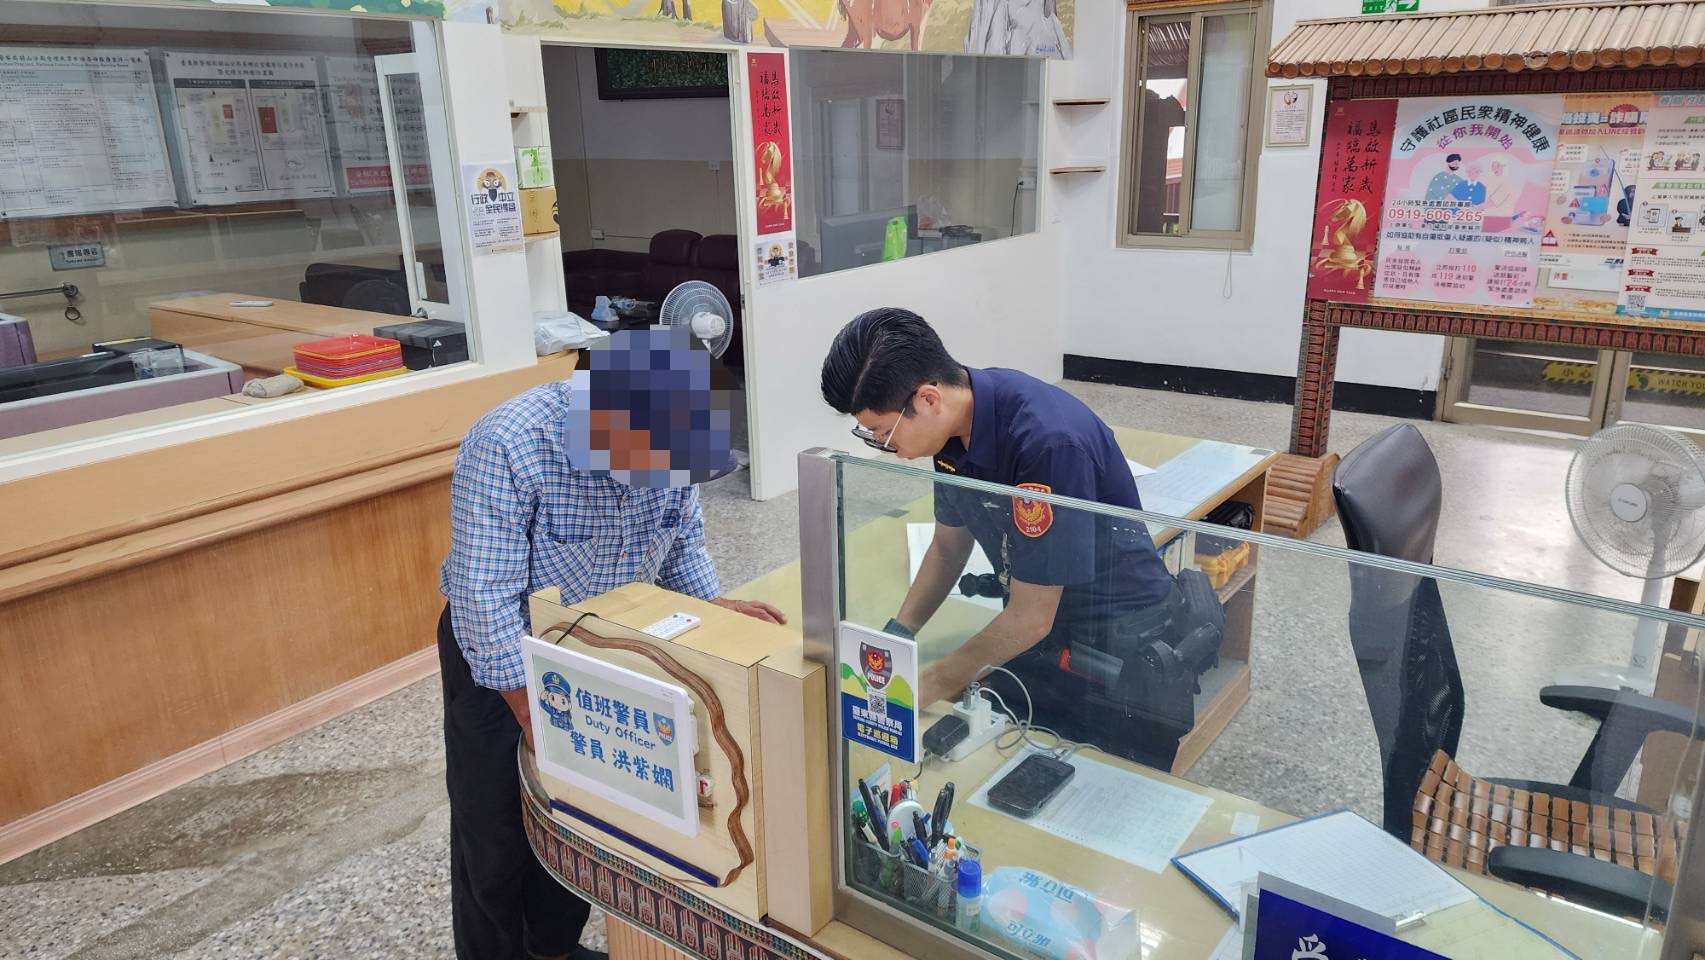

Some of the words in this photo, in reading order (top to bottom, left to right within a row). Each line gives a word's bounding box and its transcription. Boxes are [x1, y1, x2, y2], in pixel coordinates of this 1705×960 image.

[1400, 105, 1550, 153] 守護社區民眾精神健康
[1437, 123, 1513, 150] 從你我開始
[1389, 208, 1482, 221] 0919-606-265
[575, 687, 651, 734] 值班警員
[852, 705, 903, 731] 臺東縣警察局
[570, 730, 606, 764] 警員
[585, 715, 610, 734] Duty
[615, 727, 656, 751] Officer
[1007, 920, 1053, 947] 可立雅
